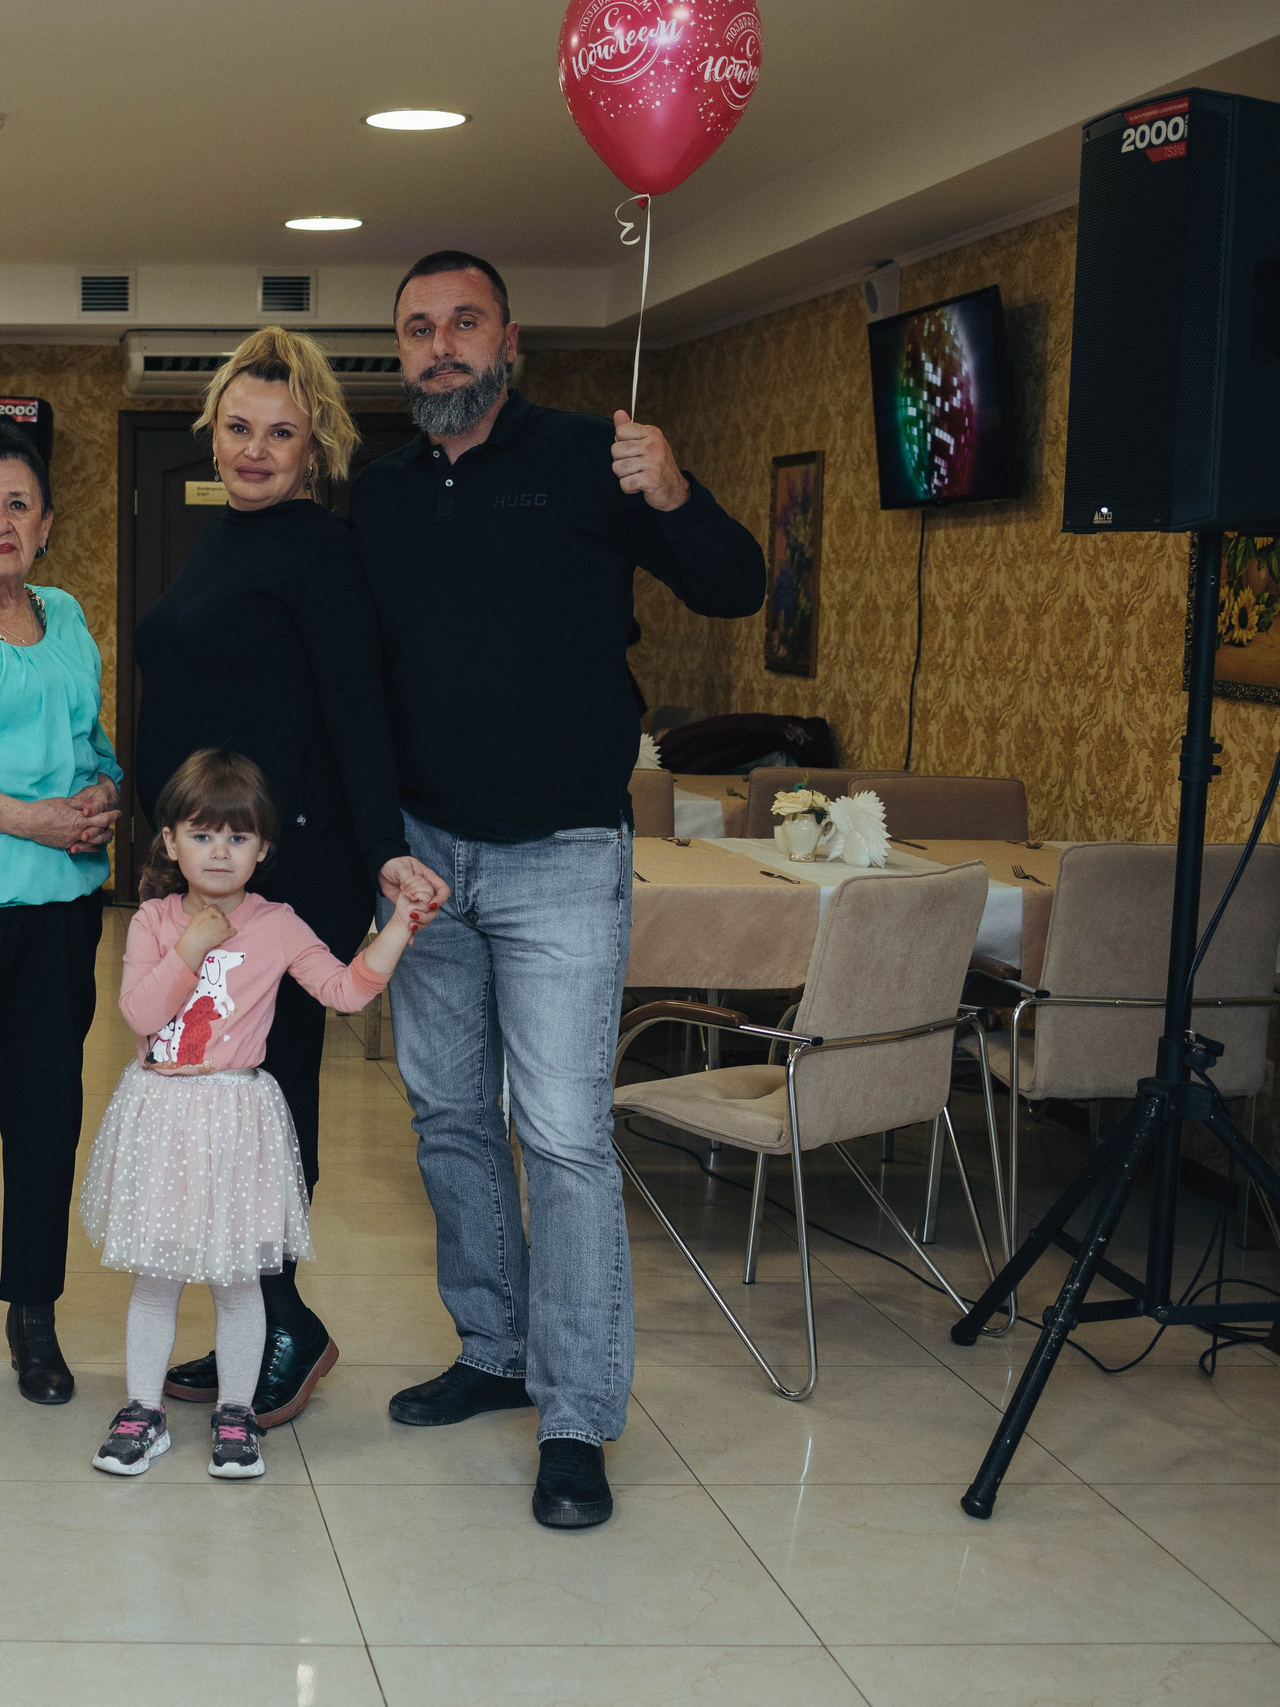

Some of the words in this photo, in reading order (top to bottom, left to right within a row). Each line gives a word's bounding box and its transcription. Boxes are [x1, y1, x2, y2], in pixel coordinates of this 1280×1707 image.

[571, 17, 684, 81] Юбилеем
[697, 55, 760, 86] Юбилее
[1121, 116, 1185, 154] 2000
